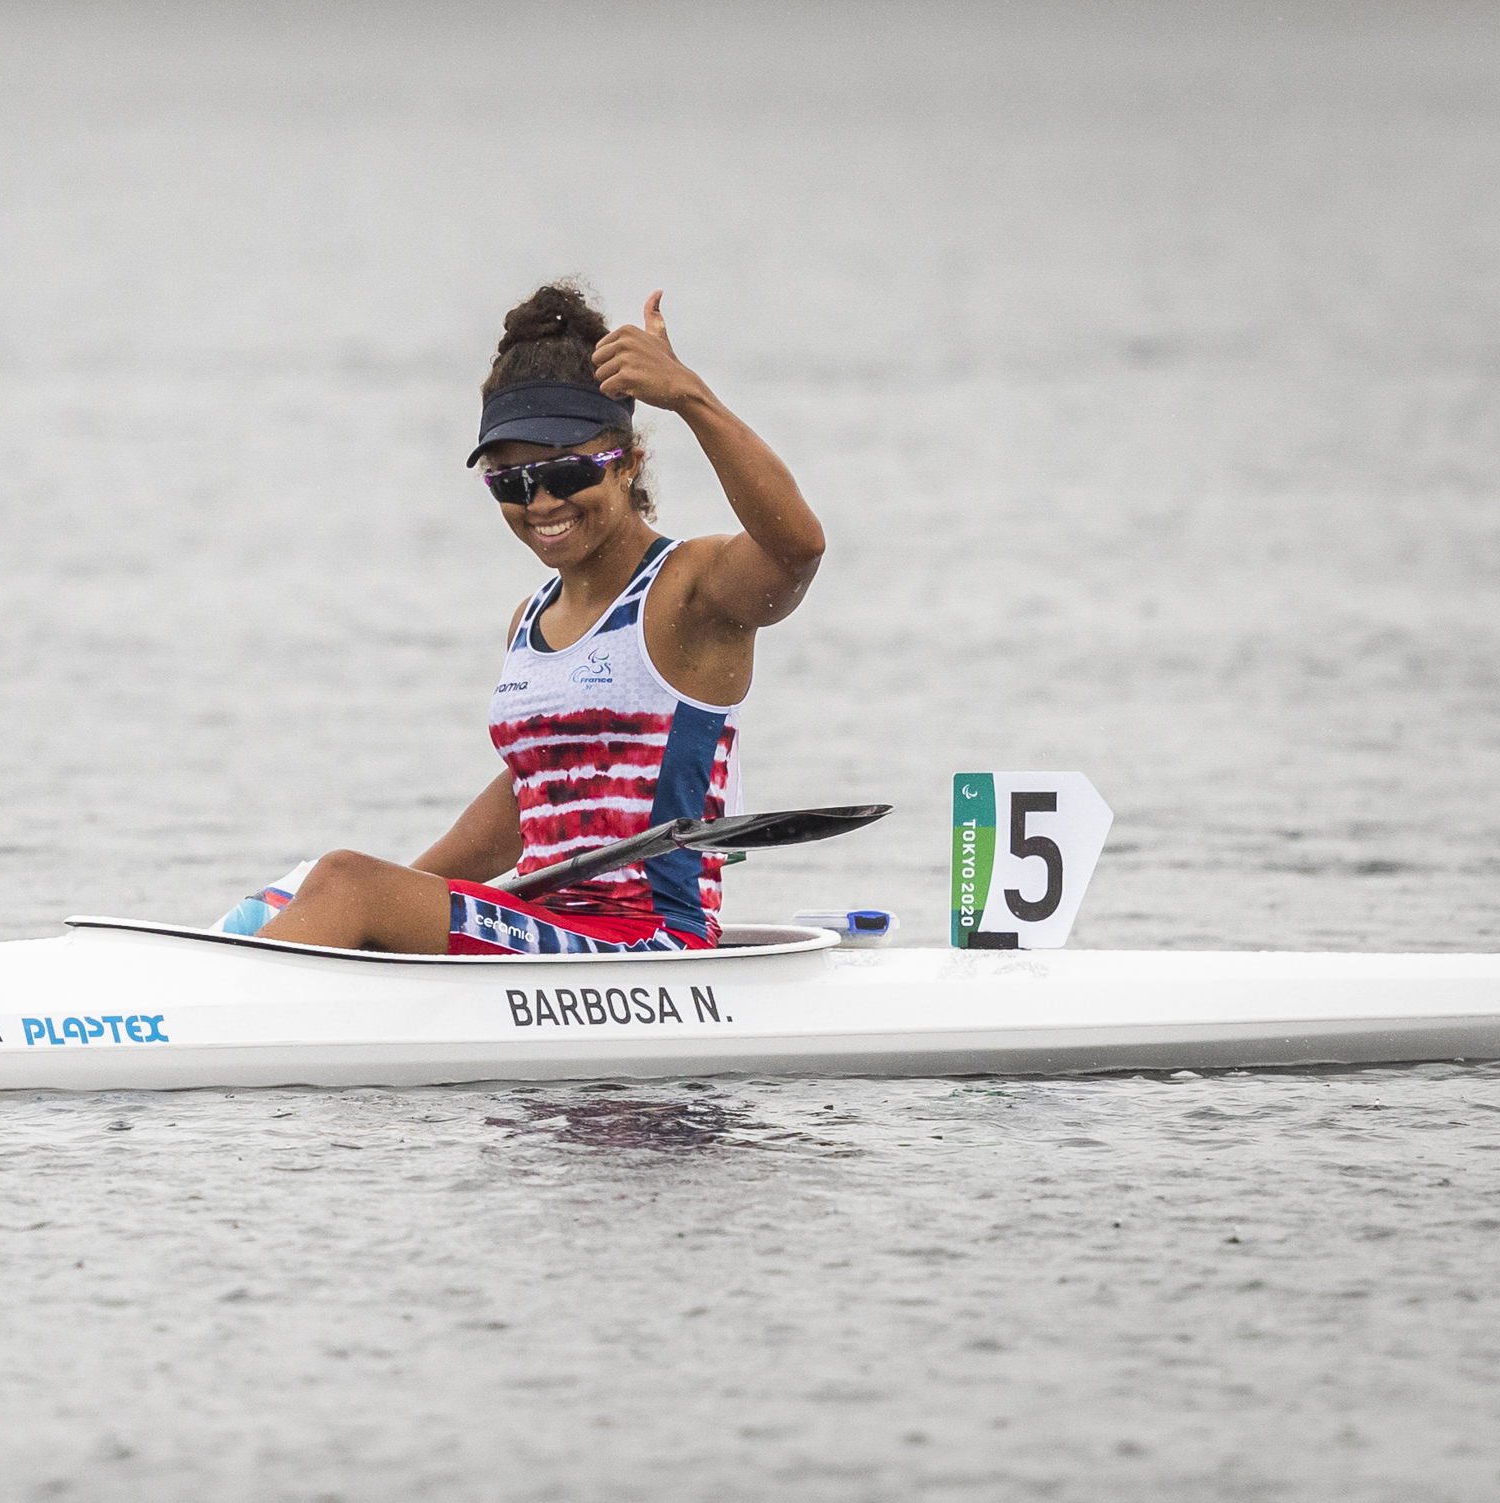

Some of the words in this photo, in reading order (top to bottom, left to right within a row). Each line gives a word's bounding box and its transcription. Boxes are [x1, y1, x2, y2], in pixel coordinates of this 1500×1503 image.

[962, 819, 976, 879] TOKYO
[1003, 791, 1063, 922] 5
[961, 882, 975, 927] 2020
[506, 987, 683, 1026] BARBOSA
[690, 986, 733, 1023] N.
[21, 1015, 169, 1045] PLASTEX
